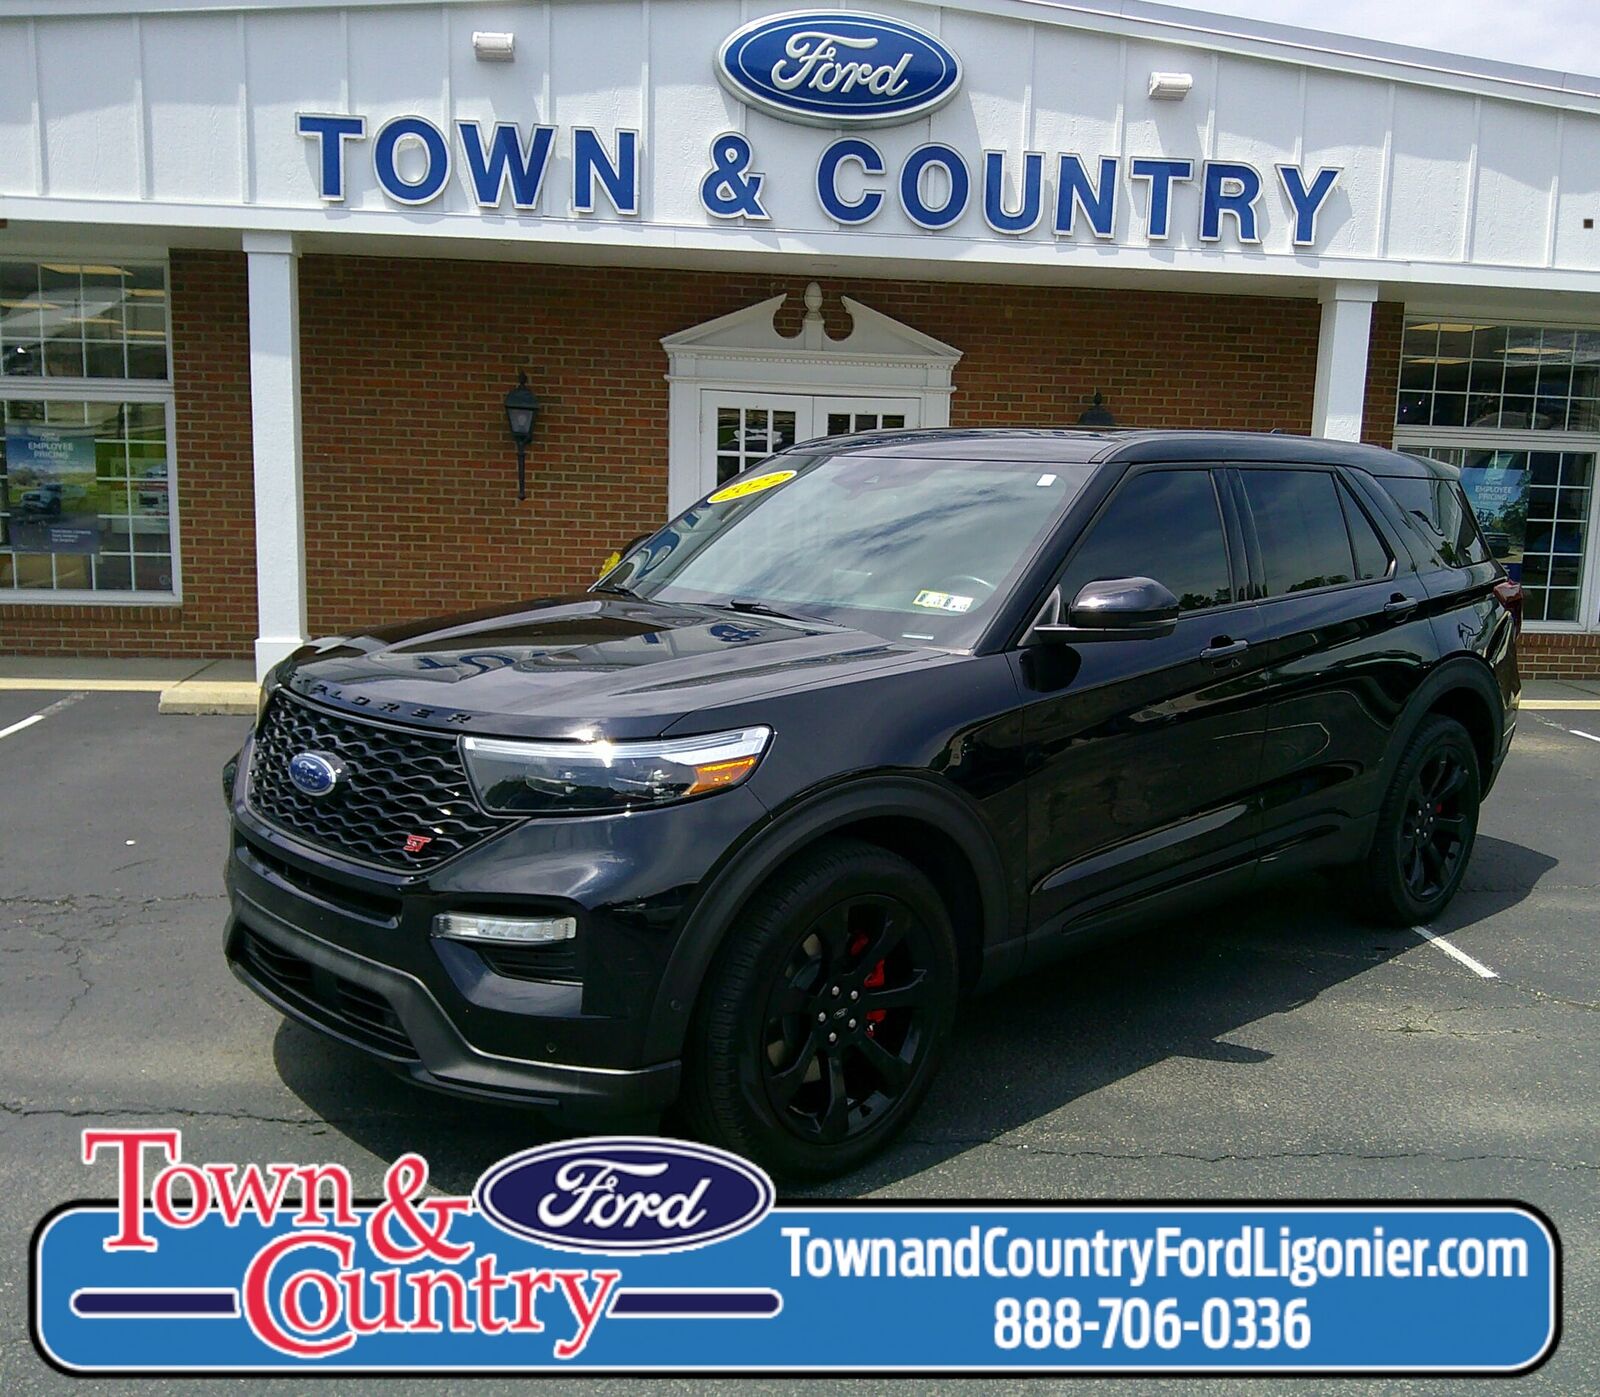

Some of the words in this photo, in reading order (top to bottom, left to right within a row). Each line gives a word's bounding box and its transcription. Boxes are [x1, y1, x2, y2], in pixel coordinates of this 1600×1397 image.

[770, 30, 914, 97] Ford
[296, 112, 640, 215] TOWN
[700, 131, 770, 220] &
[816, 136, 1344, 247] COUNTRY
[28, 441, 74, 452] EMPLOYEE
[1475, 485, 1513, 494] EMPLOYEE
[403, 834, 432, 852] ST
